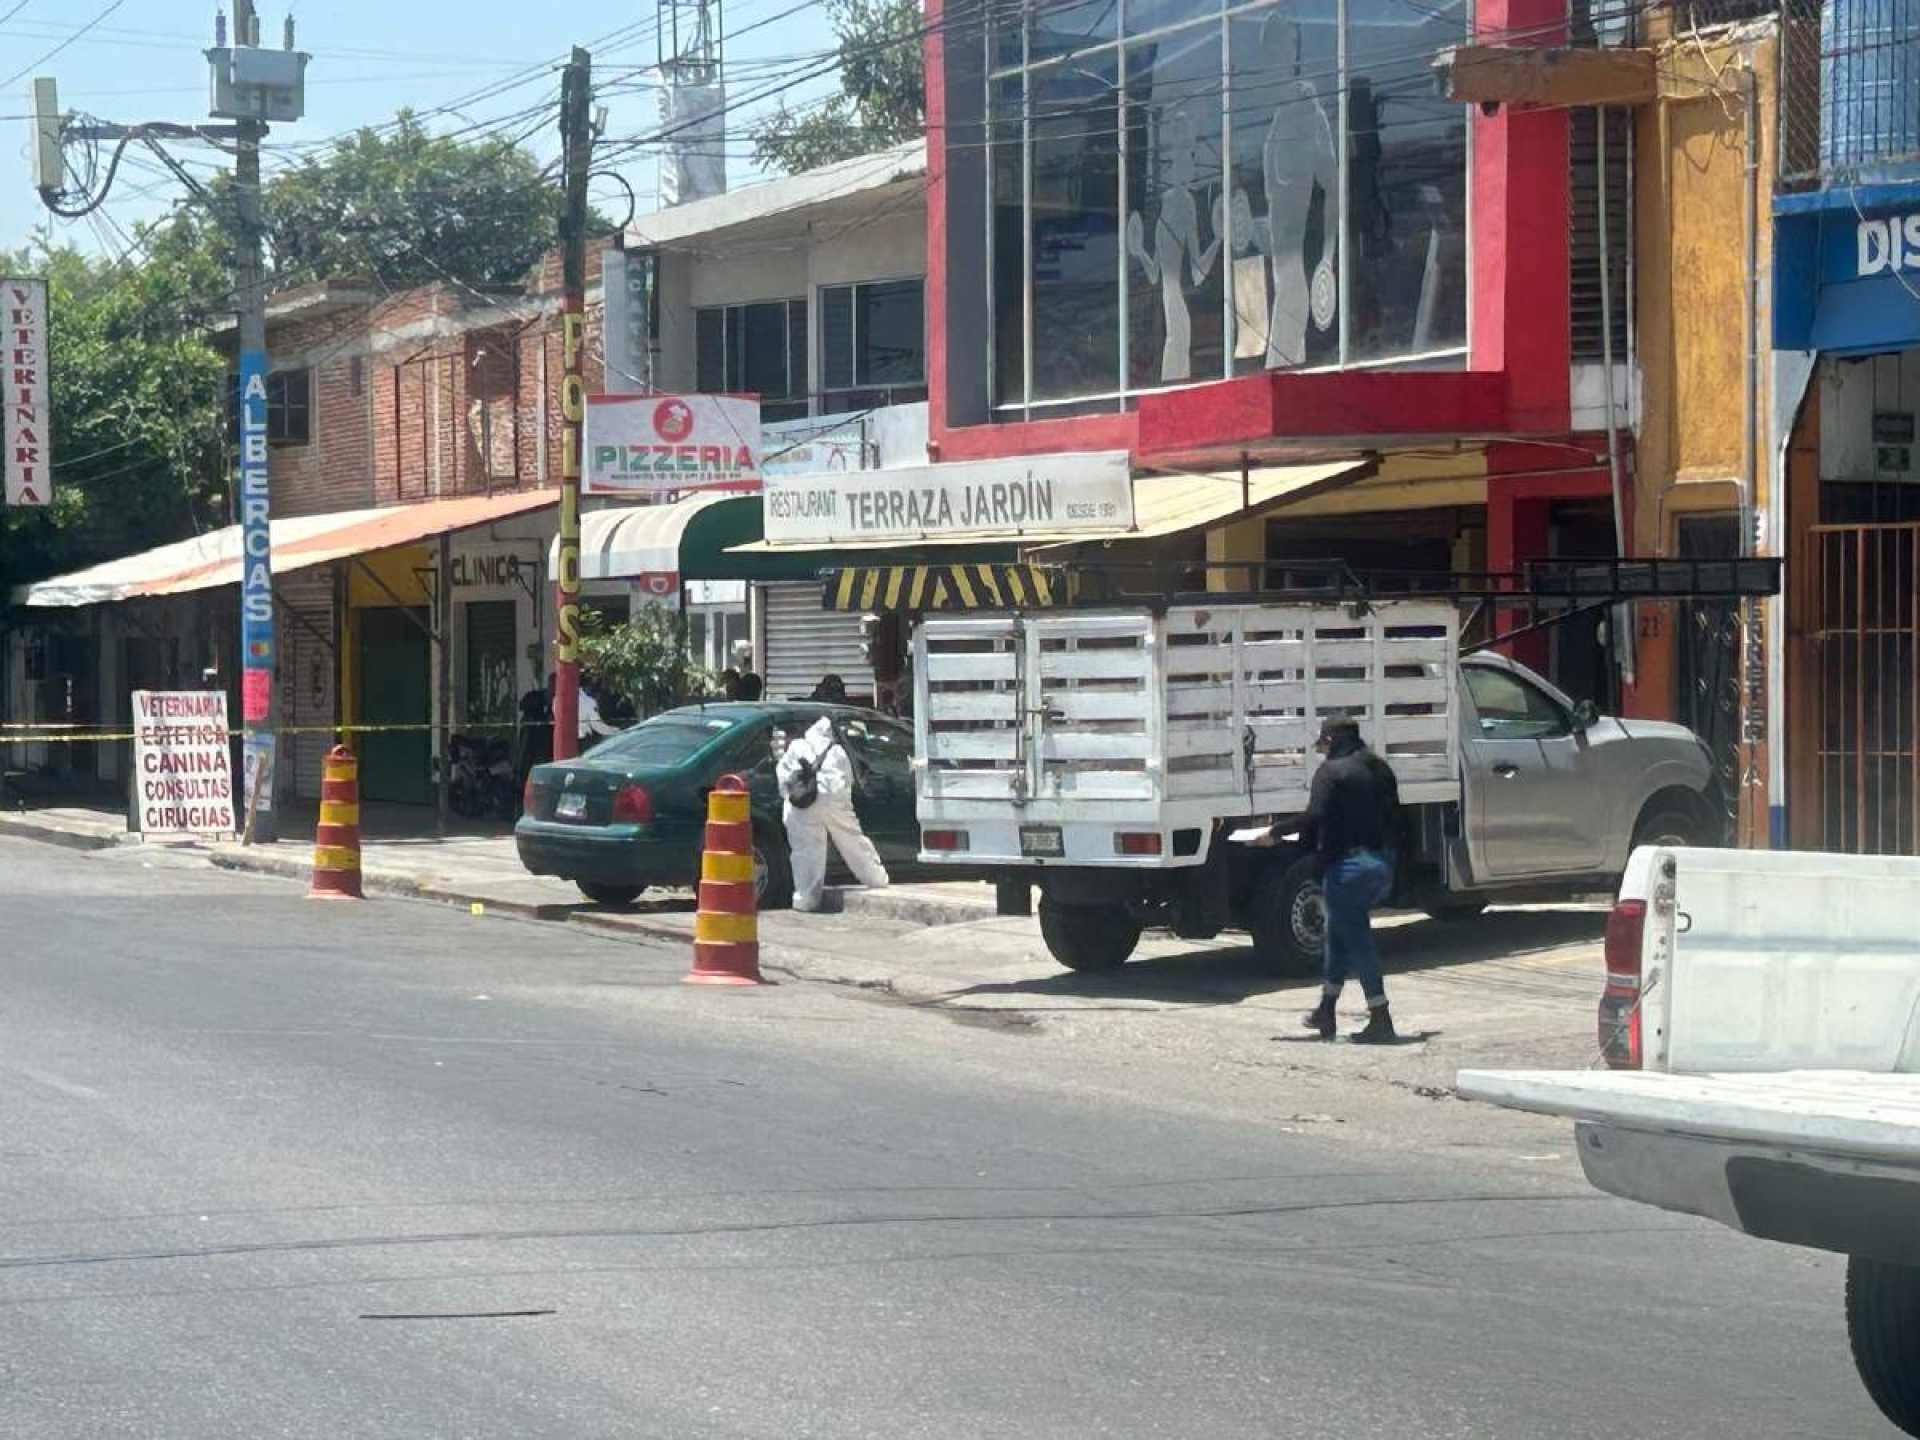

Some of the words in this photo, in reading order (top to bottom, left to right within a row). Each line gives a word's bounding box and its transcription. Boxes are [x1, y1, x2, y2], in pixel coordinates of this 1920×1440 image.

[12, 288, 40, 503] VETERINARIA
[594, 445, 756, 472] PIZZERIA
[243, 373, 273, 622] ALBERCAS
[770, 489, 837, 518] RESTAURANT
[845, 487, 952, 530] TERRAZA
[960, 470, 1053, 526] JARDÍN
[450, 553, 519, 586] CLINICA
[139, 695, 224, 718] VETERINARIA
[141, 724, 227, 746] ESTETICA
[143, 751, 228, 774] CANINA
[145, 778, 230, 801] CONSULTAS
[146, 805, 232, 829] CIRUGIAS
